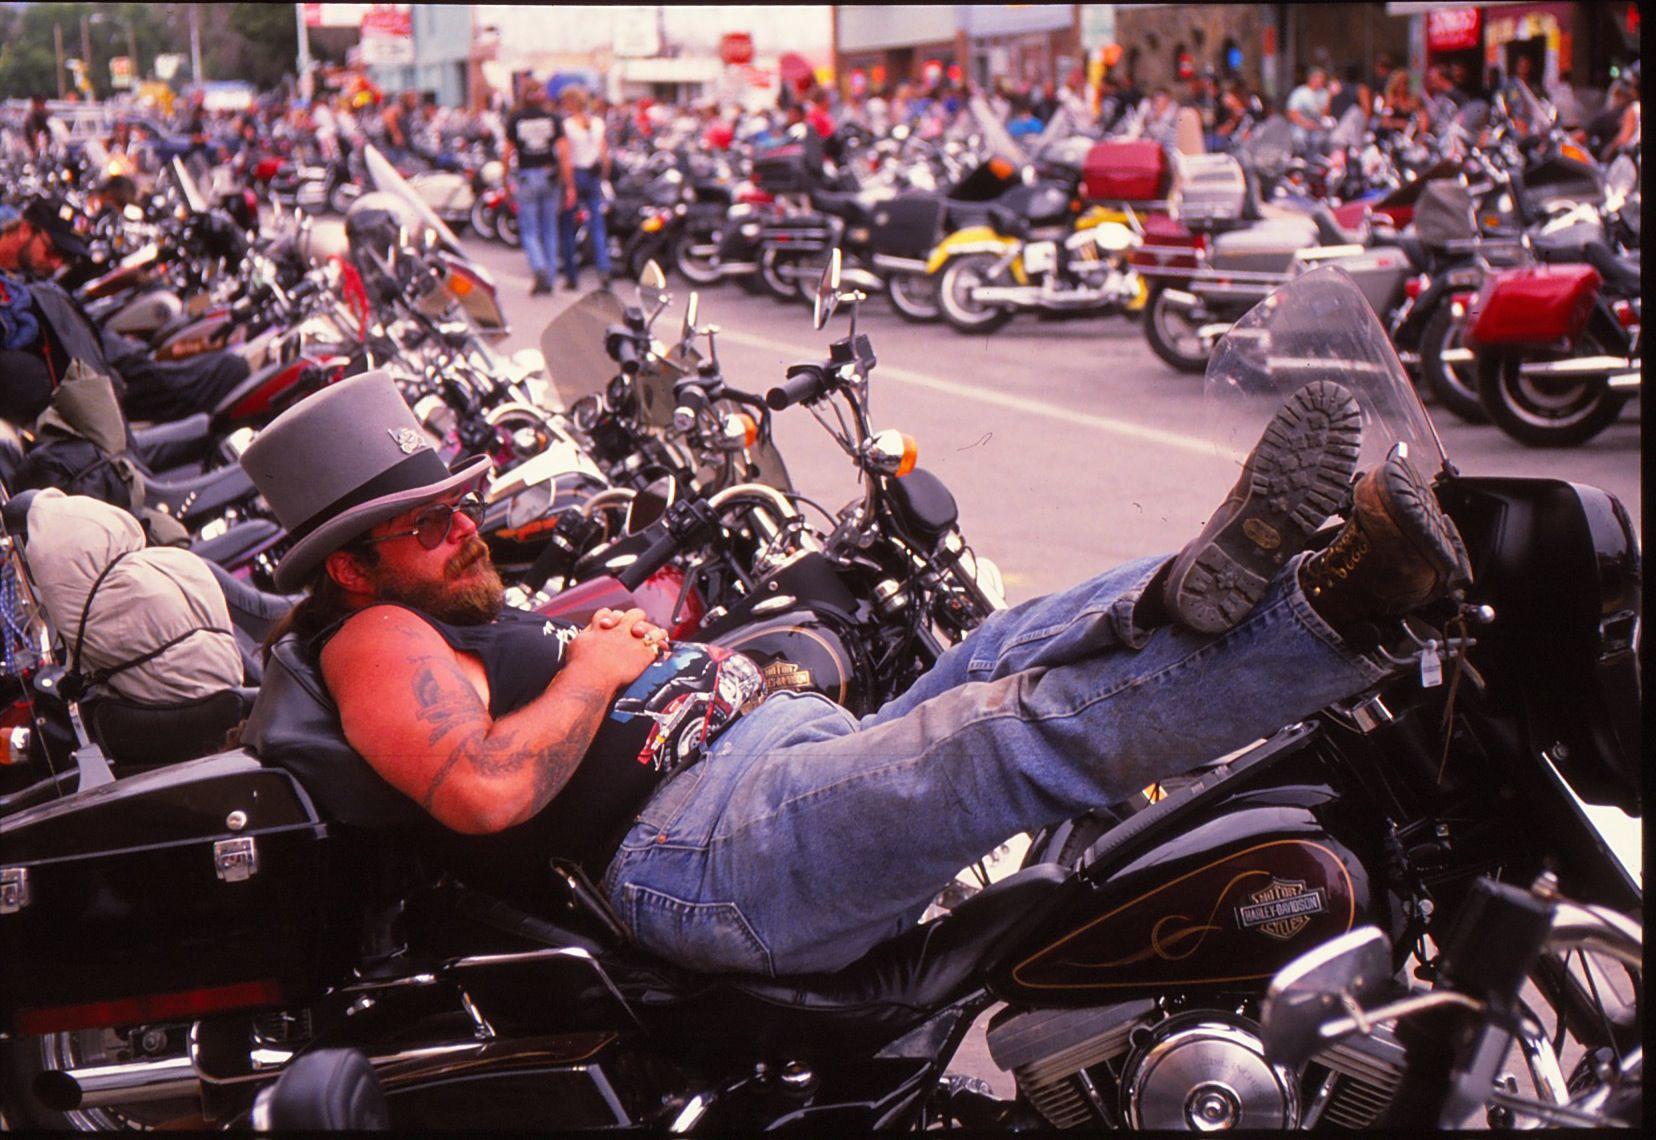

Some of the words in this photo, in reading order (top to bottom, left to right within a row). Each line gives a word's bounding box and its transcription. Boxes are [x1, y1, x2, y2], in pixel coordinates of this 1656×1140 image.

[1259, 884, 1297, 902] MOTOR
[1244, 896, 1318, 921] HARLEY-DAVIDSON
[1266, 916, 1304, 936] CYCLES
